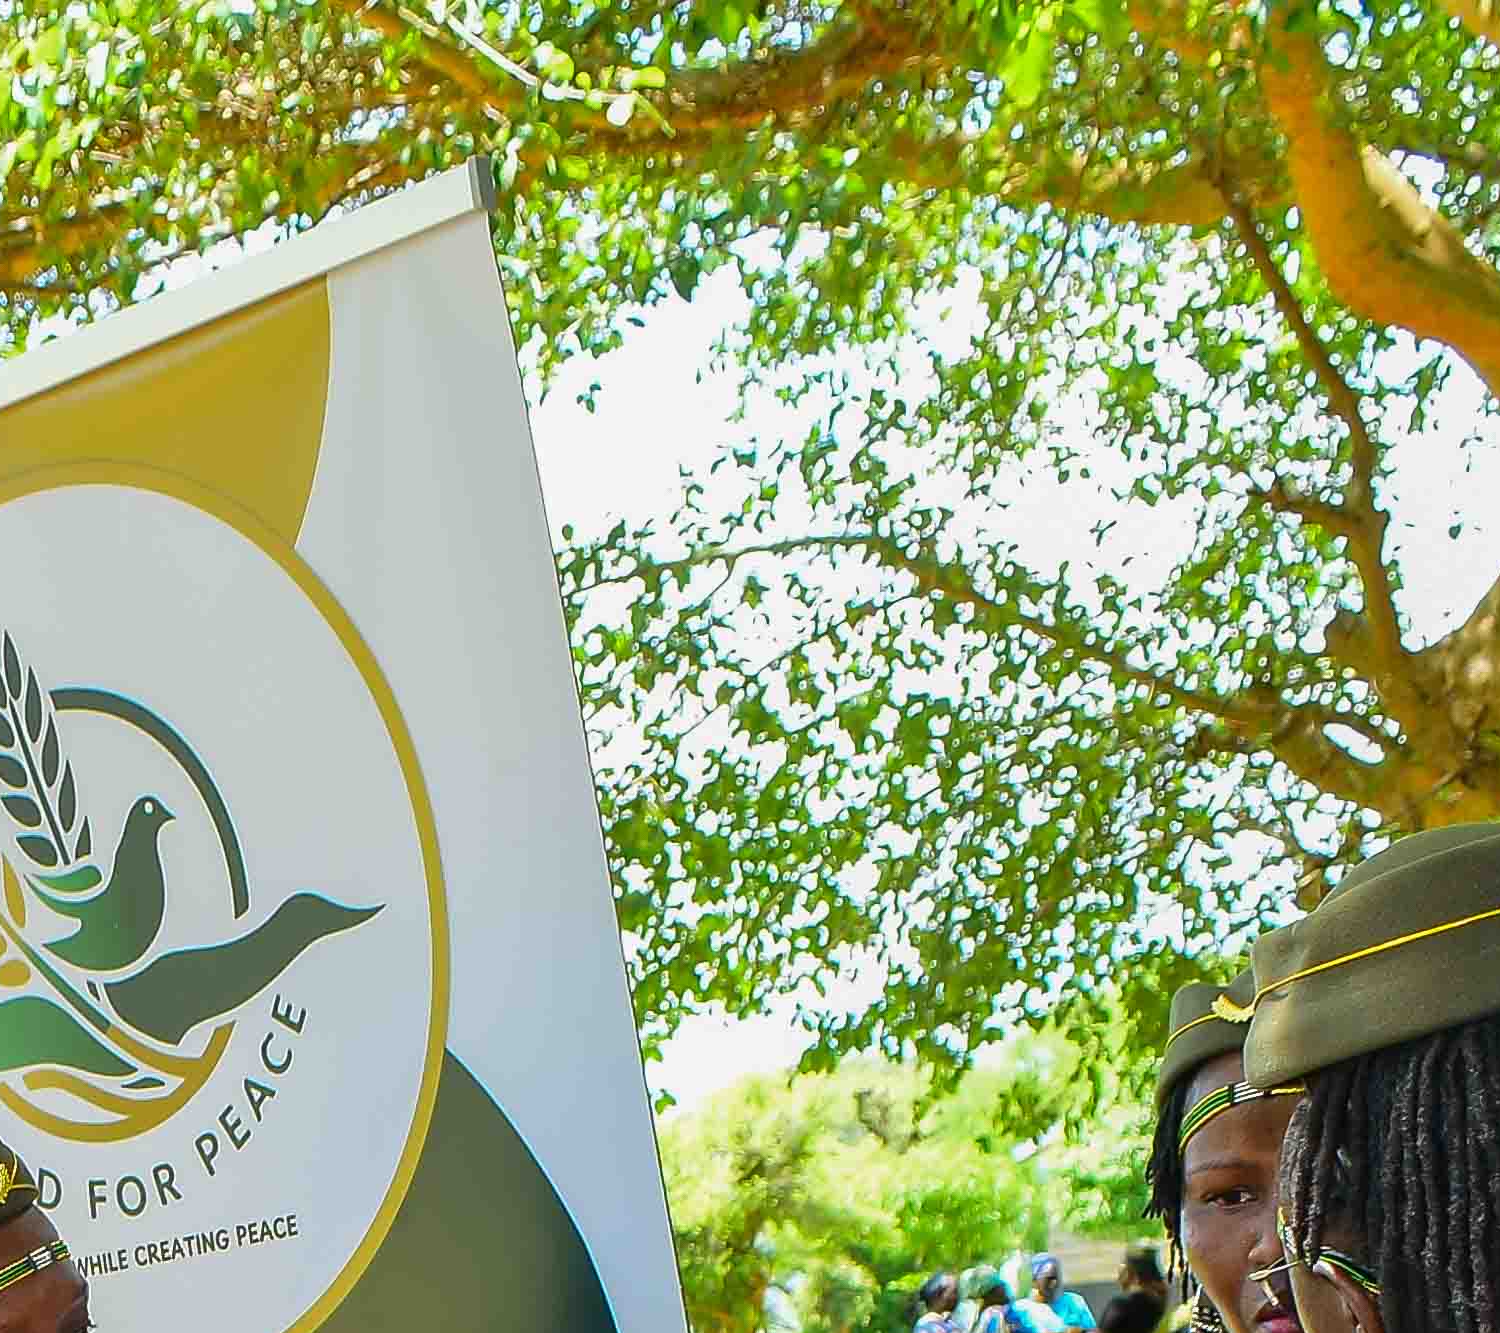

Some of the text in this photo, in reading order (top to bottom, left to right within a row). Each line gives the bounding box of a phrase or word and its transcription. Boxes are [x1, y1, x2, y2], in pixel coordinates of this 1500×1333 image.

[87, 993, 310, 1220] FOR PEACE
[73, 1214, 299, 1278] WHILE CREATING PEACE
